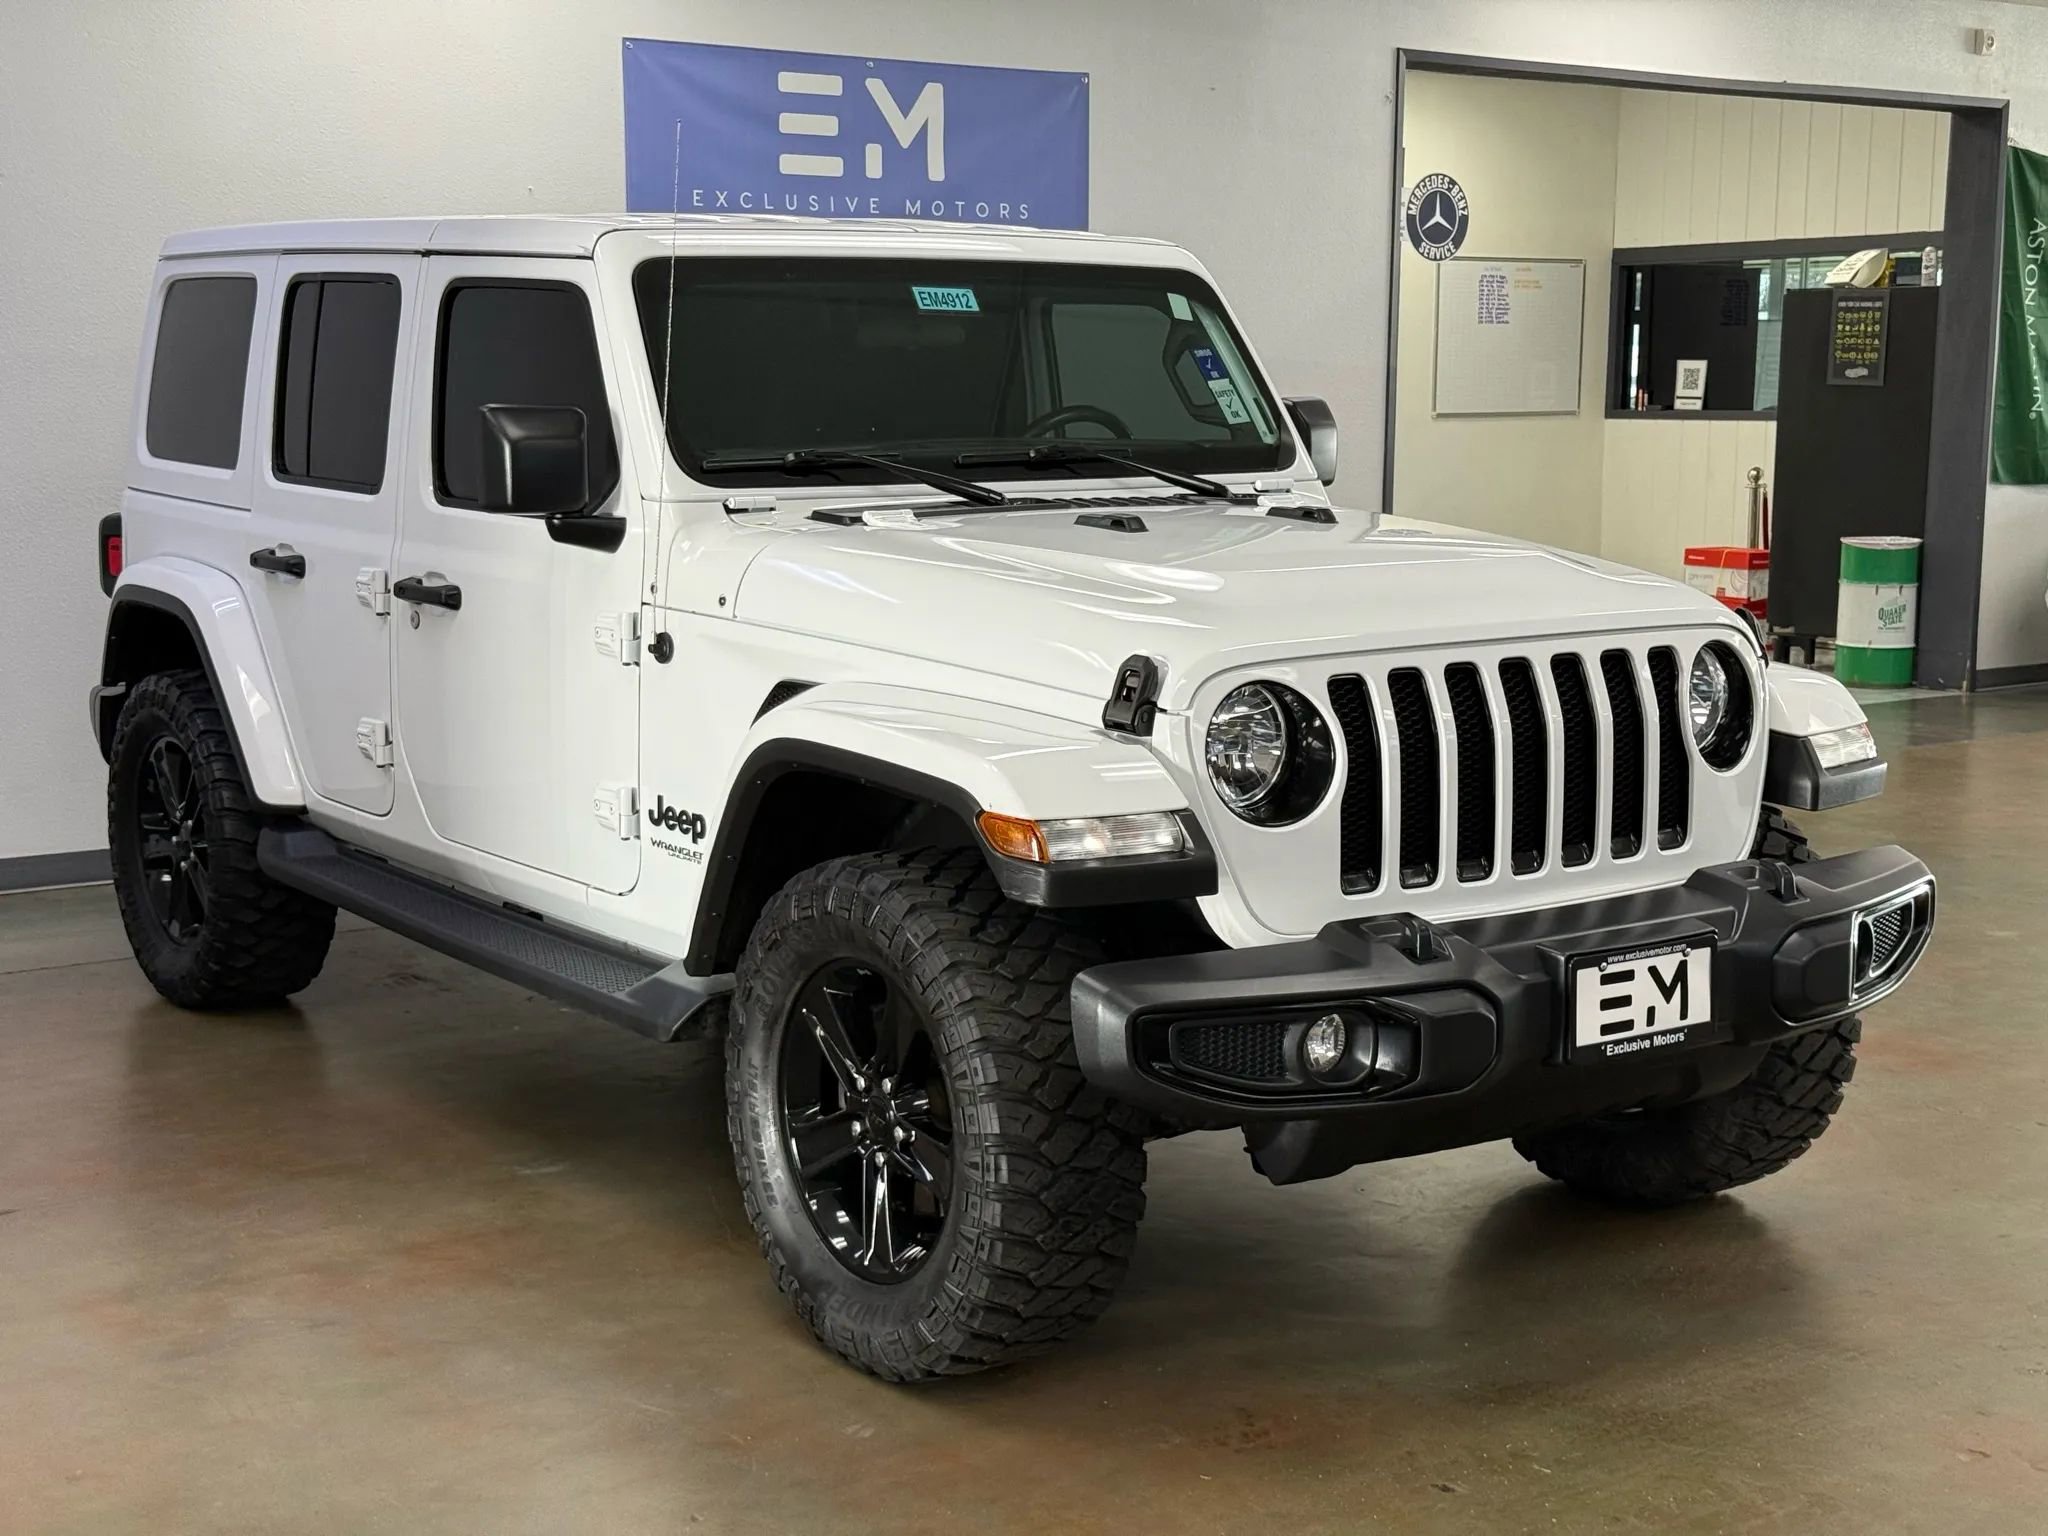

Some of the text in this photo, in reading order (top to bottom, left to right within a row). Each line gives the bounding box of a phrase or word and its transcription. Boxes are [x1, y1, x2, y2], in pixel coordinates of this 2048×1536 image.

[778, 71, 945, 182] EM
[693, 190, 1029, 219] EXCLUSIVE MOTORS
[1407, 175, 1468, 217] MERCEDES-BENZ
[1418, 241, 1457, 260] SERVICE
[2024, 217, 2048, 306] ASTON
[917, 291, 973, 309] EM4912
[1878, 604, 1906, 620] QUAKER
[1882, 616, 1904, 627] STATE
[648, 794, 707, 845] Jeep
[1607, 943, 1687, 964] www.exclusivemotor.com
[1600, 959, 1688, 1037] EM
[1606, 1032, 1685, 1056] Exclusive Motors
